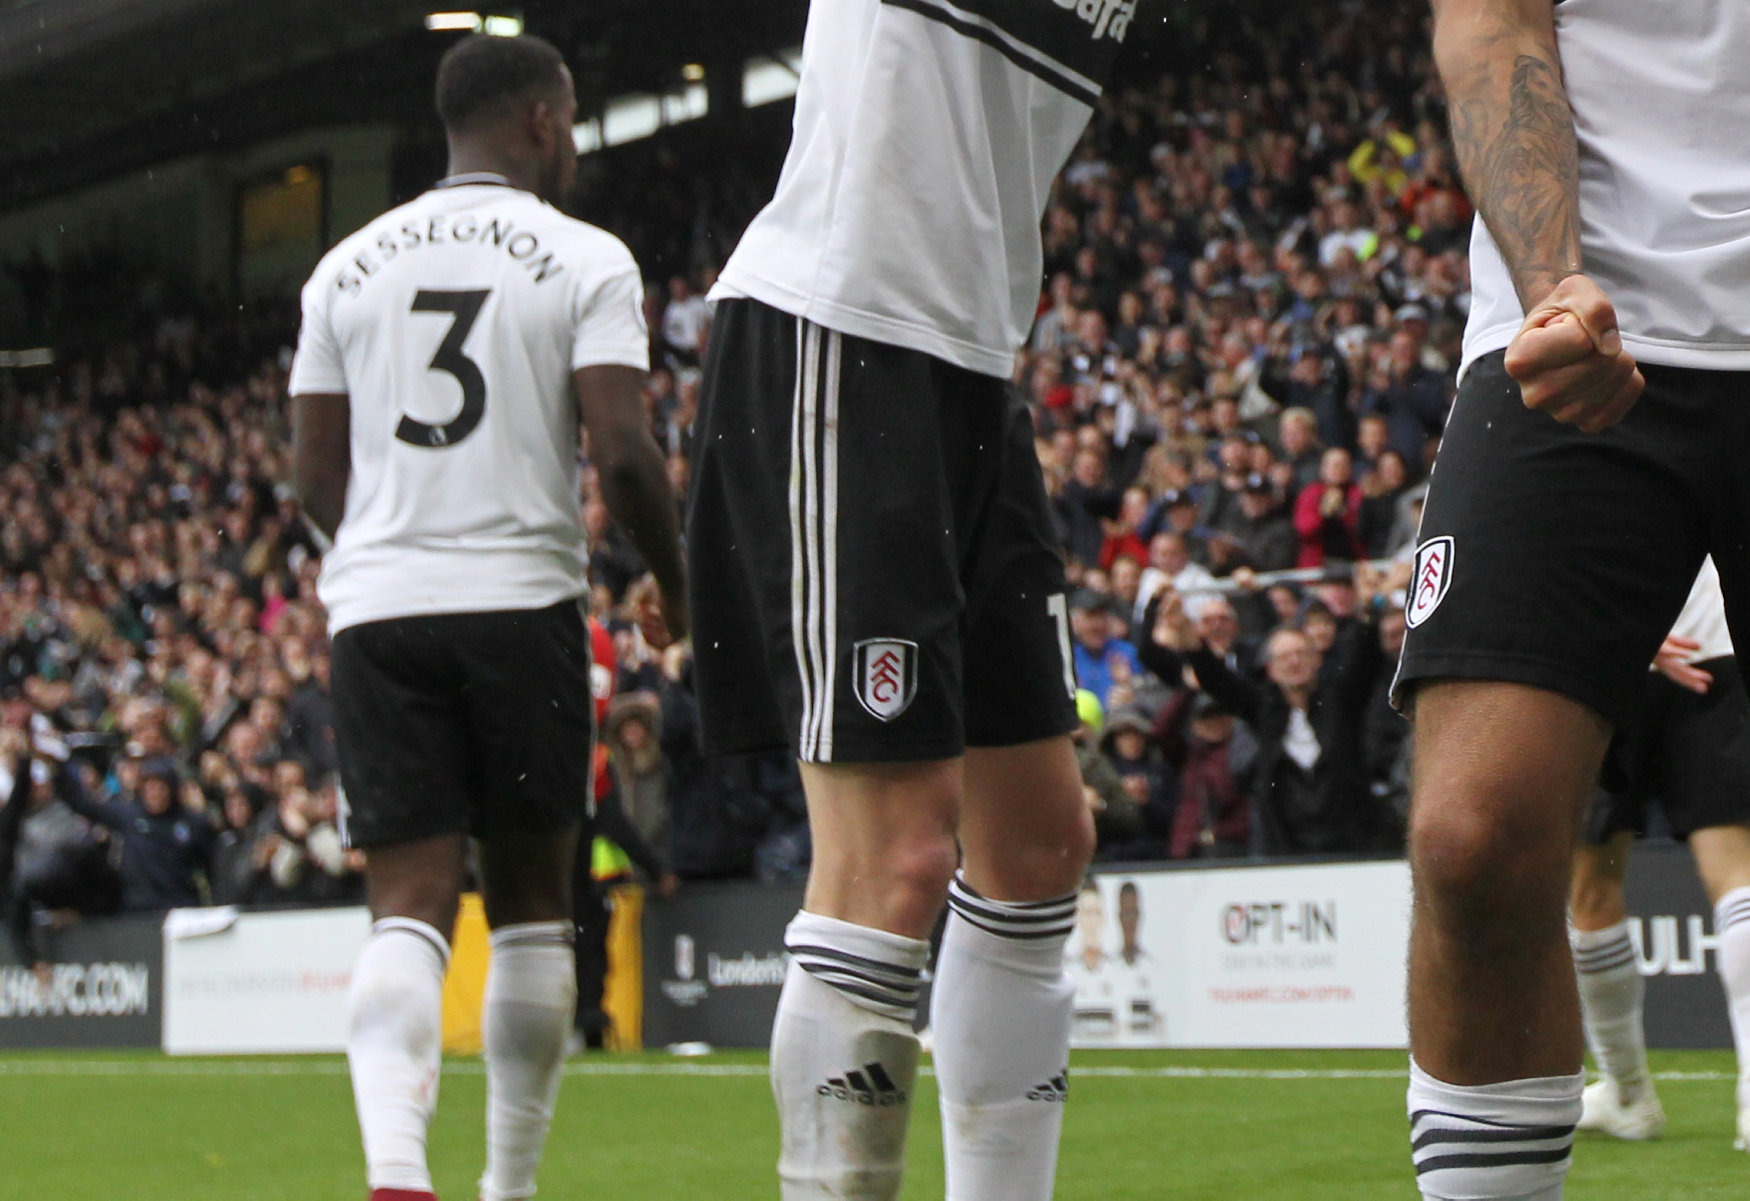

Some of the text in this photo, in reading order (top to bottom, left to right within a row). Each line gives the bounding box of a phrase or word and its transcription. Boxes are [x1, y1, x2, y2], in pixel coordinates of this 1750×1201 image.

[336, 214, 564, 298] SESSEGNON
[394, 289, 493, 447] 3
[1221, 902, 1338, 946] OPT-IN
[816, 1084, 907, 1107] adidas
